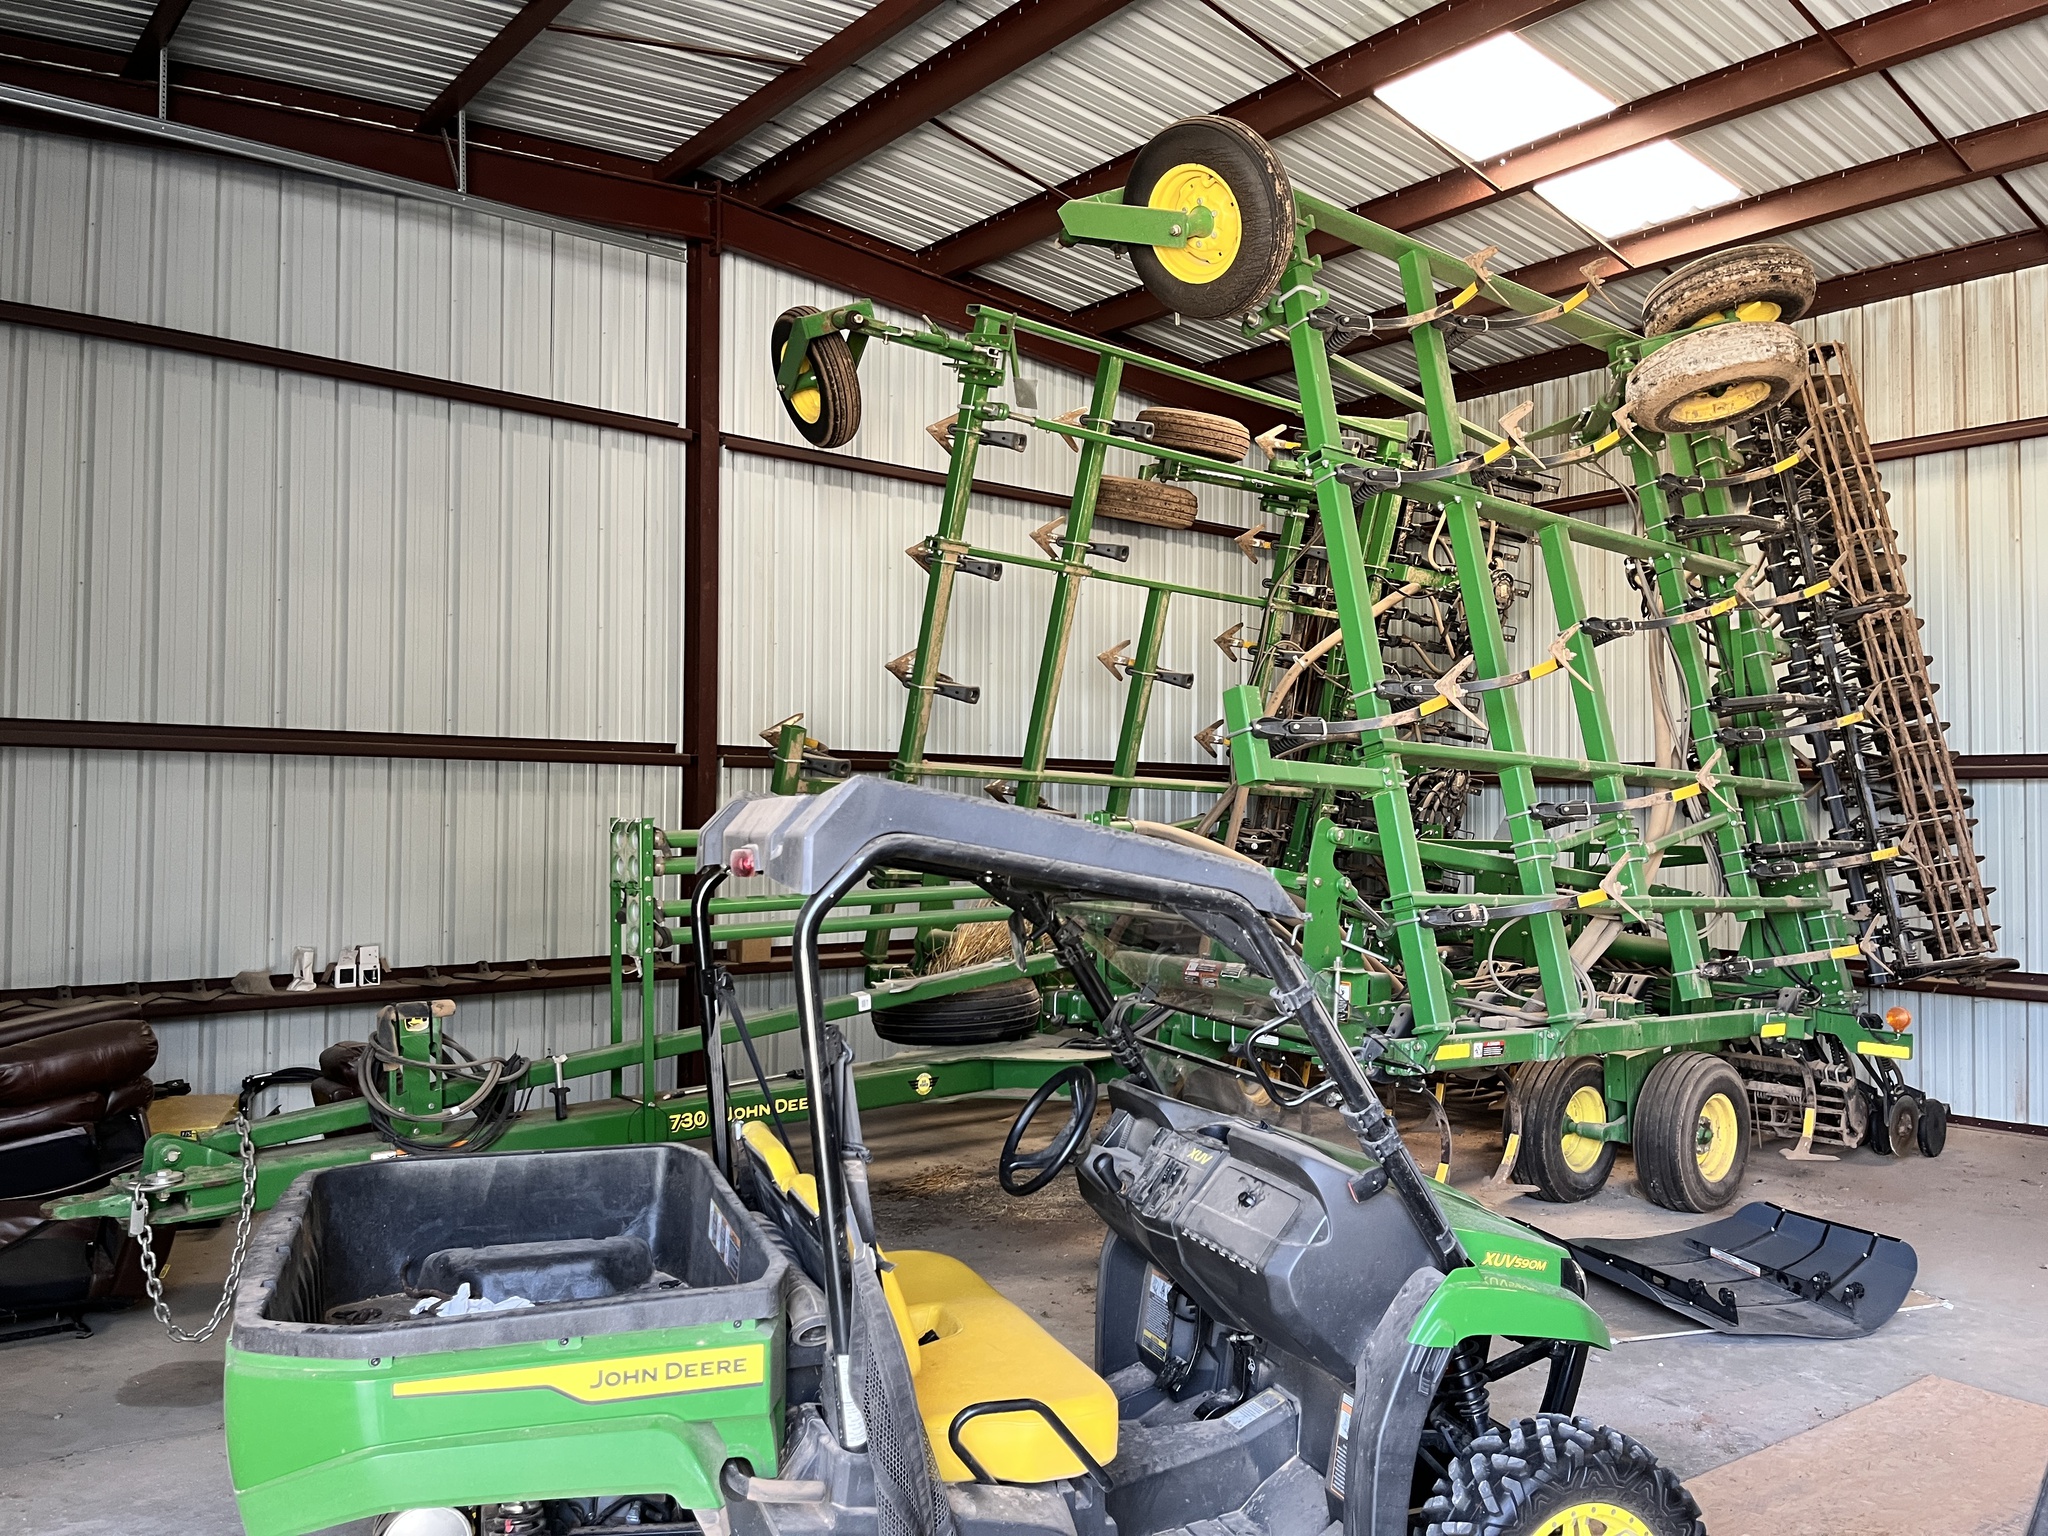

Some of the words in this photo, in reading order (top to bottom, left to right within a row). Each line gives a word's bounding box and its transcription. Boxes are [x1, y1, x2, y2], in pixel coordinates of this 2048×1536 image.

[727, 1103, 771, 1122] JOHN
[774, 1097, 809, 1114] DEE
[669, 1110, 708, 1133] 730
[1186, 1147, 1213, 1165] XUV
[1481, 1251, 1548, 1272] XUV590M
[589, 1367, 658, 1389] JOHN
[665, 1358, 747, 1381] DEERE
